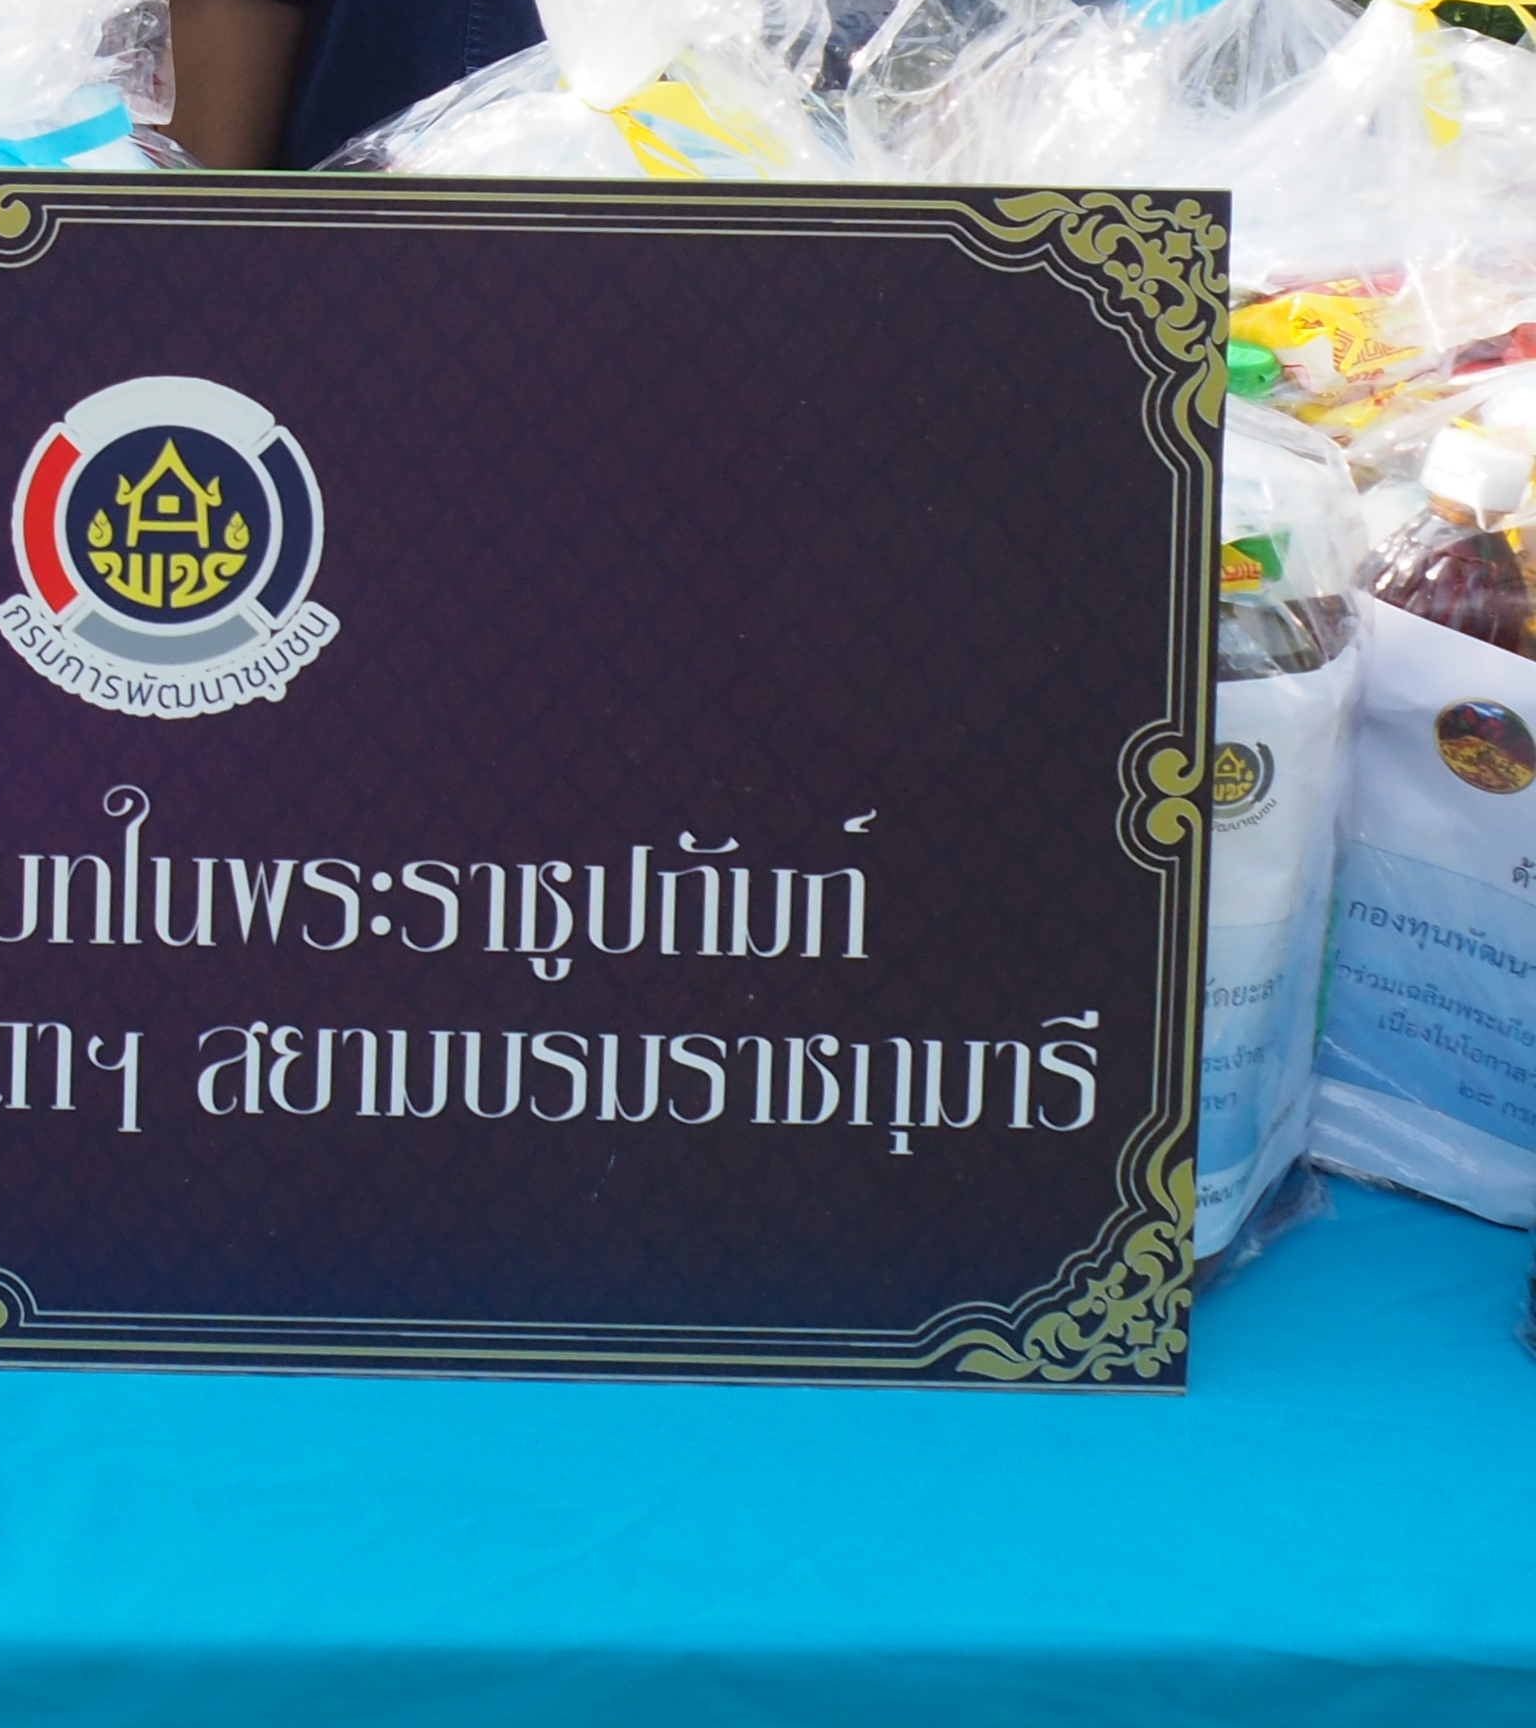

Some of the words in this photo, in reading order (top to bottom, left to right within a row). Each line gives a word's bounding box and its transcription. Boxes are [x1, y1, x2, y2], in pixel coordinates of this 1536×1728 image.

[2, 601, 331, 710] กรมการพัฒนาชุมชน
[197, 1010, 1100, 1156] สยามบรมราชกุมารี
